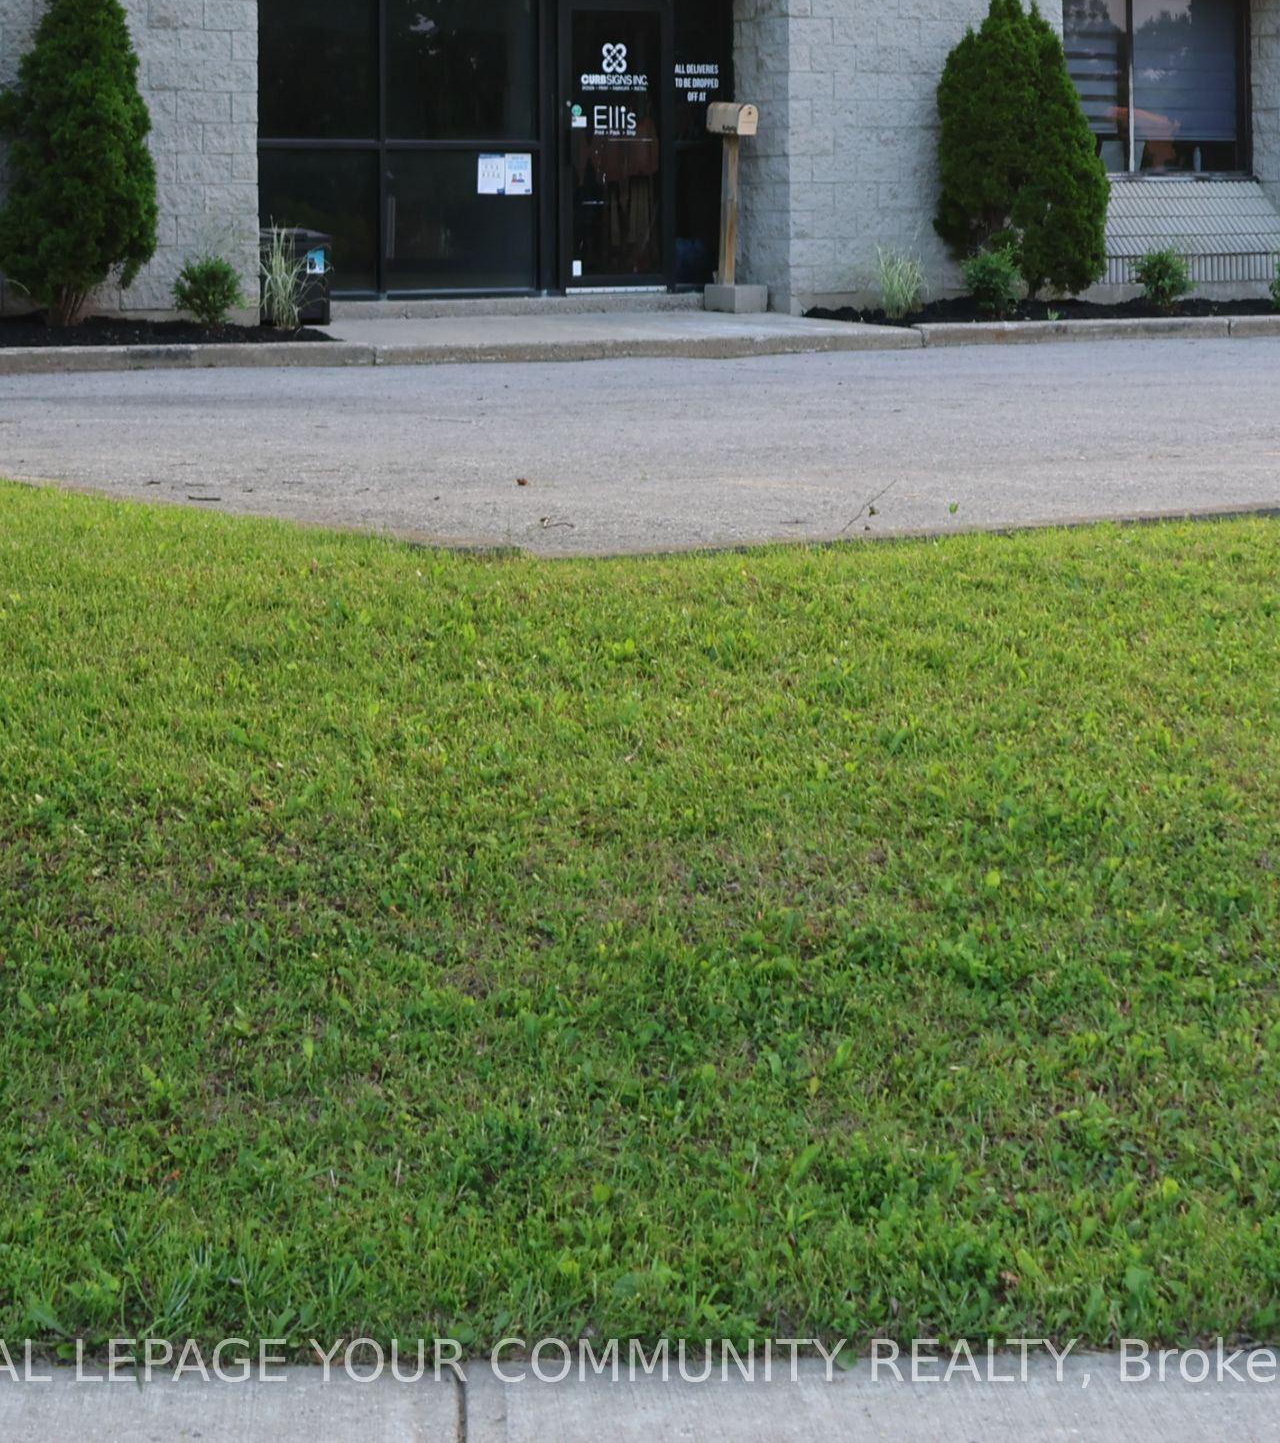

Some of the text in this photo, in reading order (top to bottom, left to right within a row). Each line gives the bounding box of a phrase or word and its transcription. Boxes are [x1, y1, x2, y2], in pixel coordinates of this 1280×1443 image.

[674, 63, 719, 74] ALL DELIVERIES
[675, 77, 719, 89] TO BE DROPPED
[687, 91, 707, 102] OFF AT
[594, 105, 637, 130] Ellis
